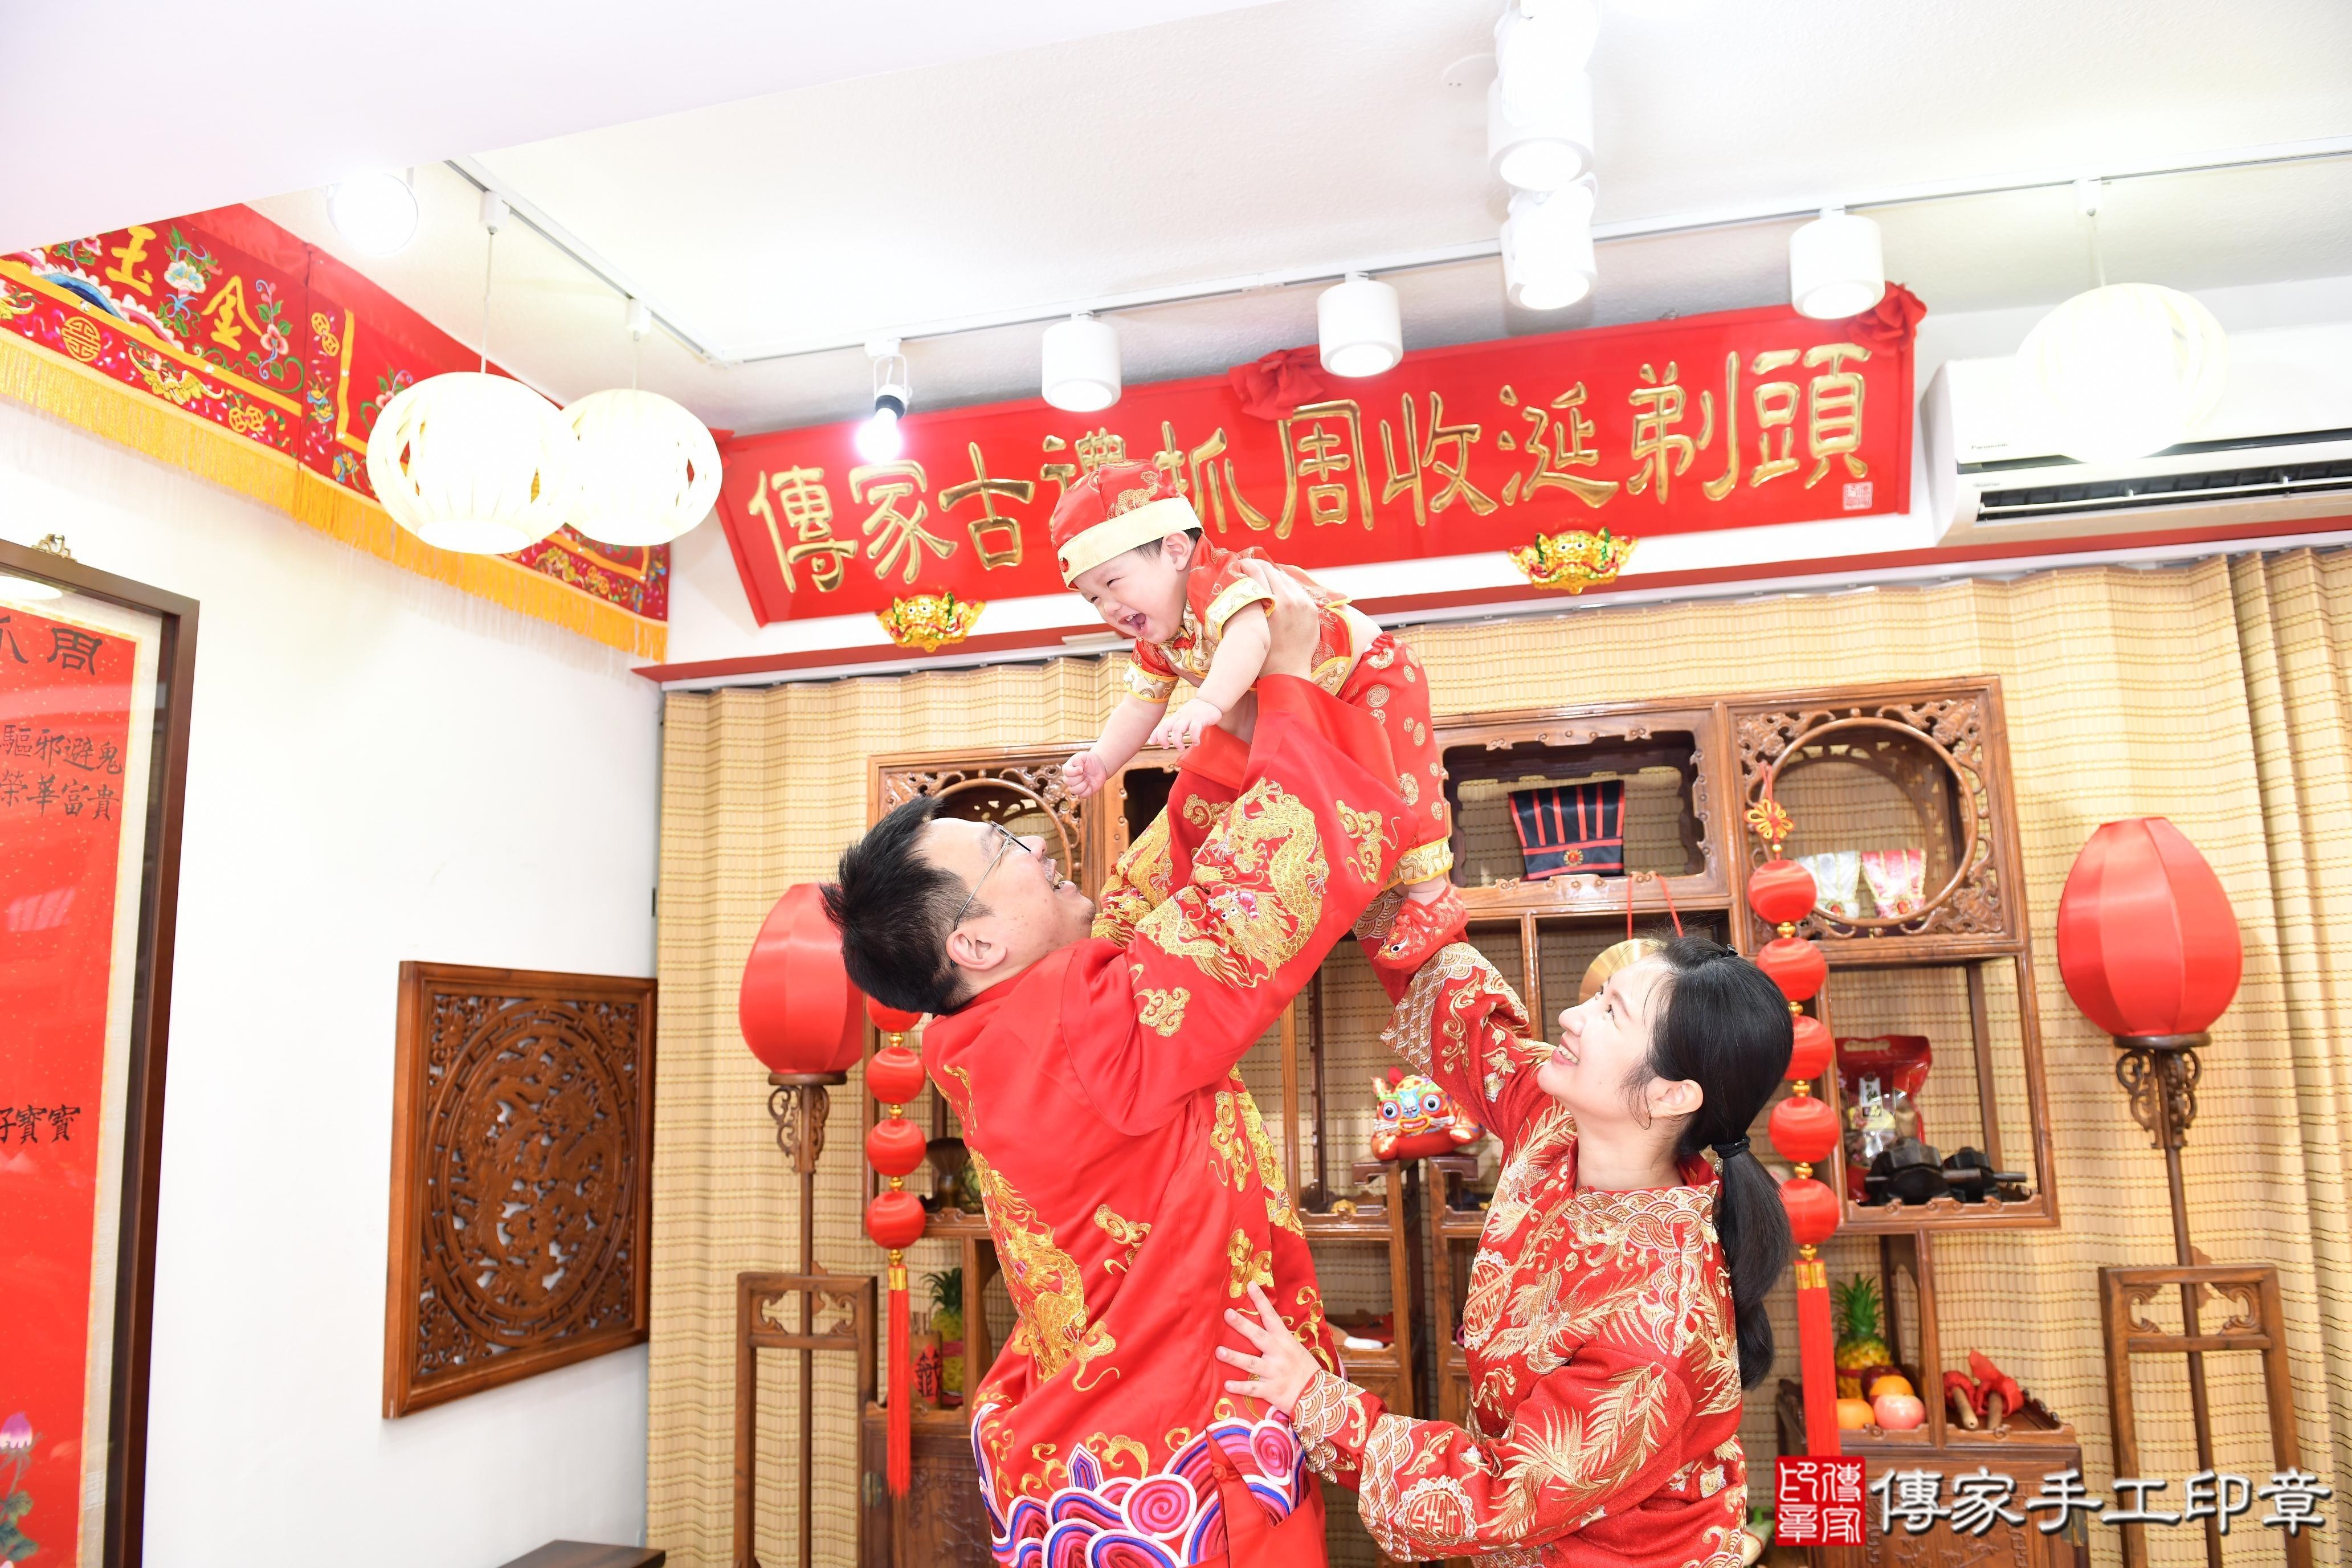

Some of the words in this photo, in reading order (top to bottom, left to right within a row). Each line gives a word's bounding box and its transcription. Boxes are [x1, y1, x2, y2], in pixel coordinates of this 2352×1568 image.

[0, 724, 122, 774] 驅邪避鬼
[0, 769, 120, 821] 榮華富貴
